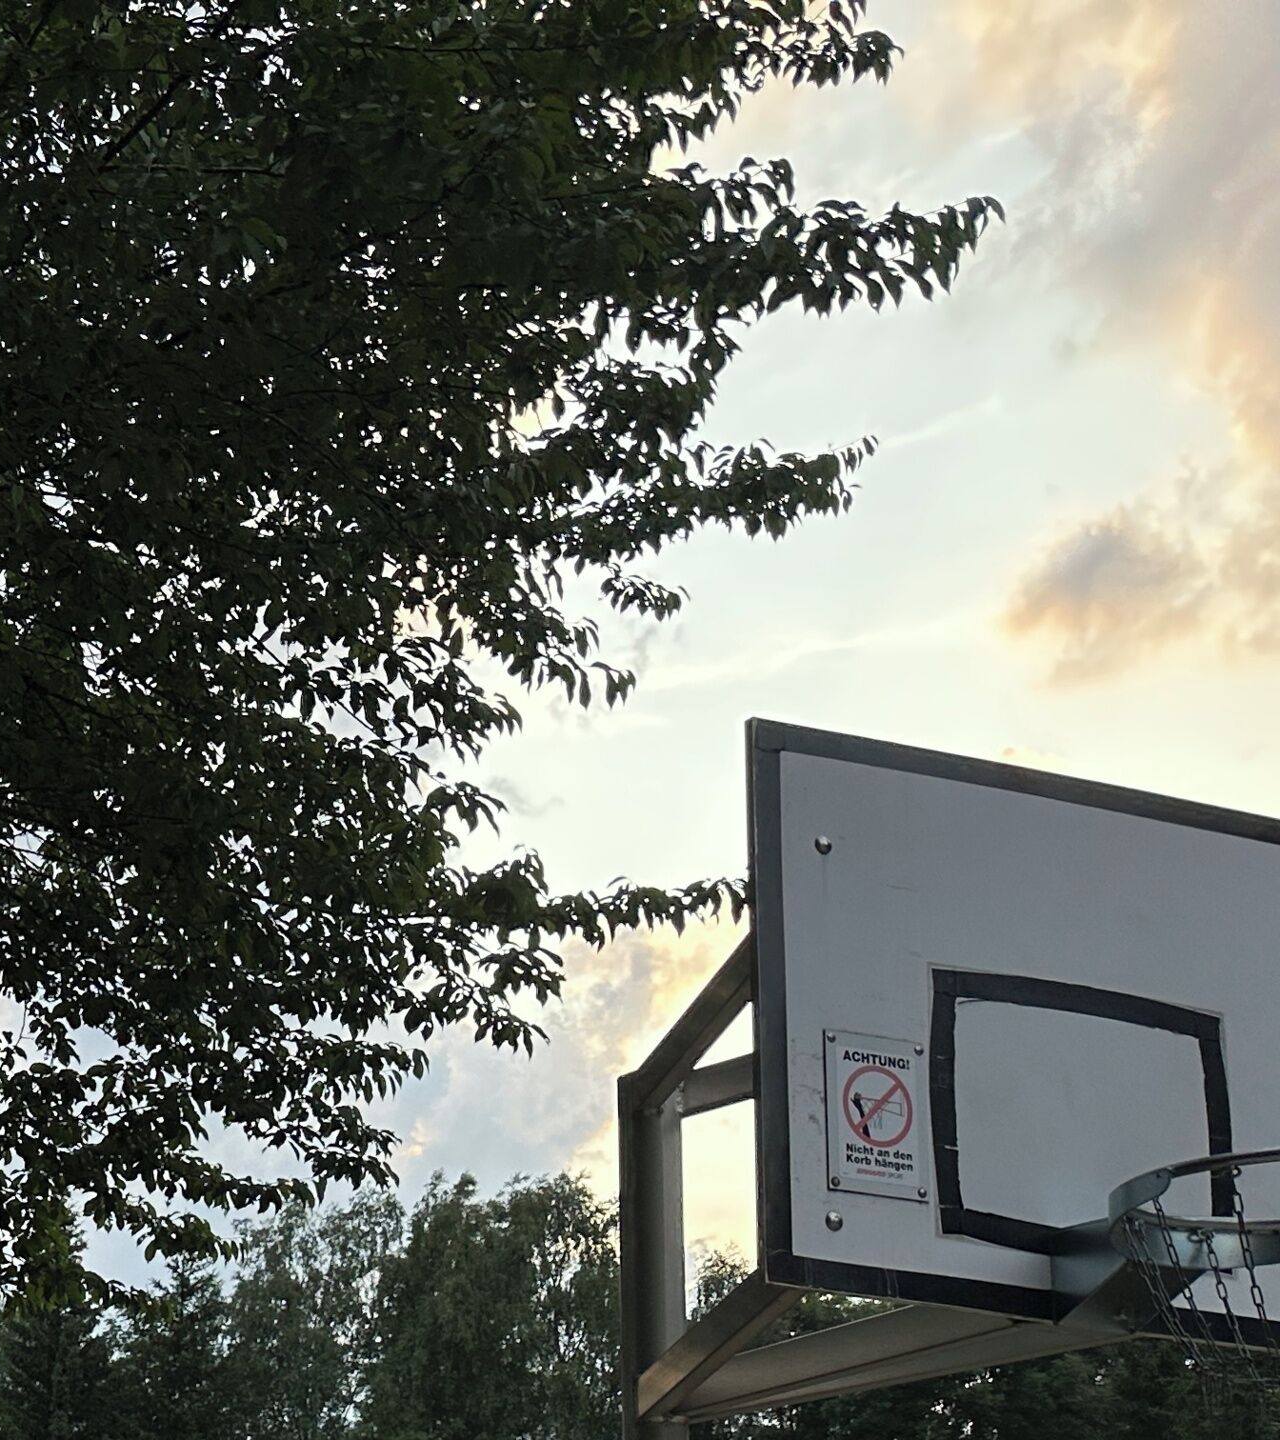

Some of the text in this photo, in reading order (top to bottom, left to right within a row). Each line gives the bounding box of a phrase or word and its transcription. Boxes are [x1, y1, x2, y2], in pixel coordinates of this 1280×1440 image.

[843, 1050, 910, 1070] ACHTUNG!
[846, 1143, 913, 1161] Nicht an den
[846, 1153, 913, 1171] Korb hängen
